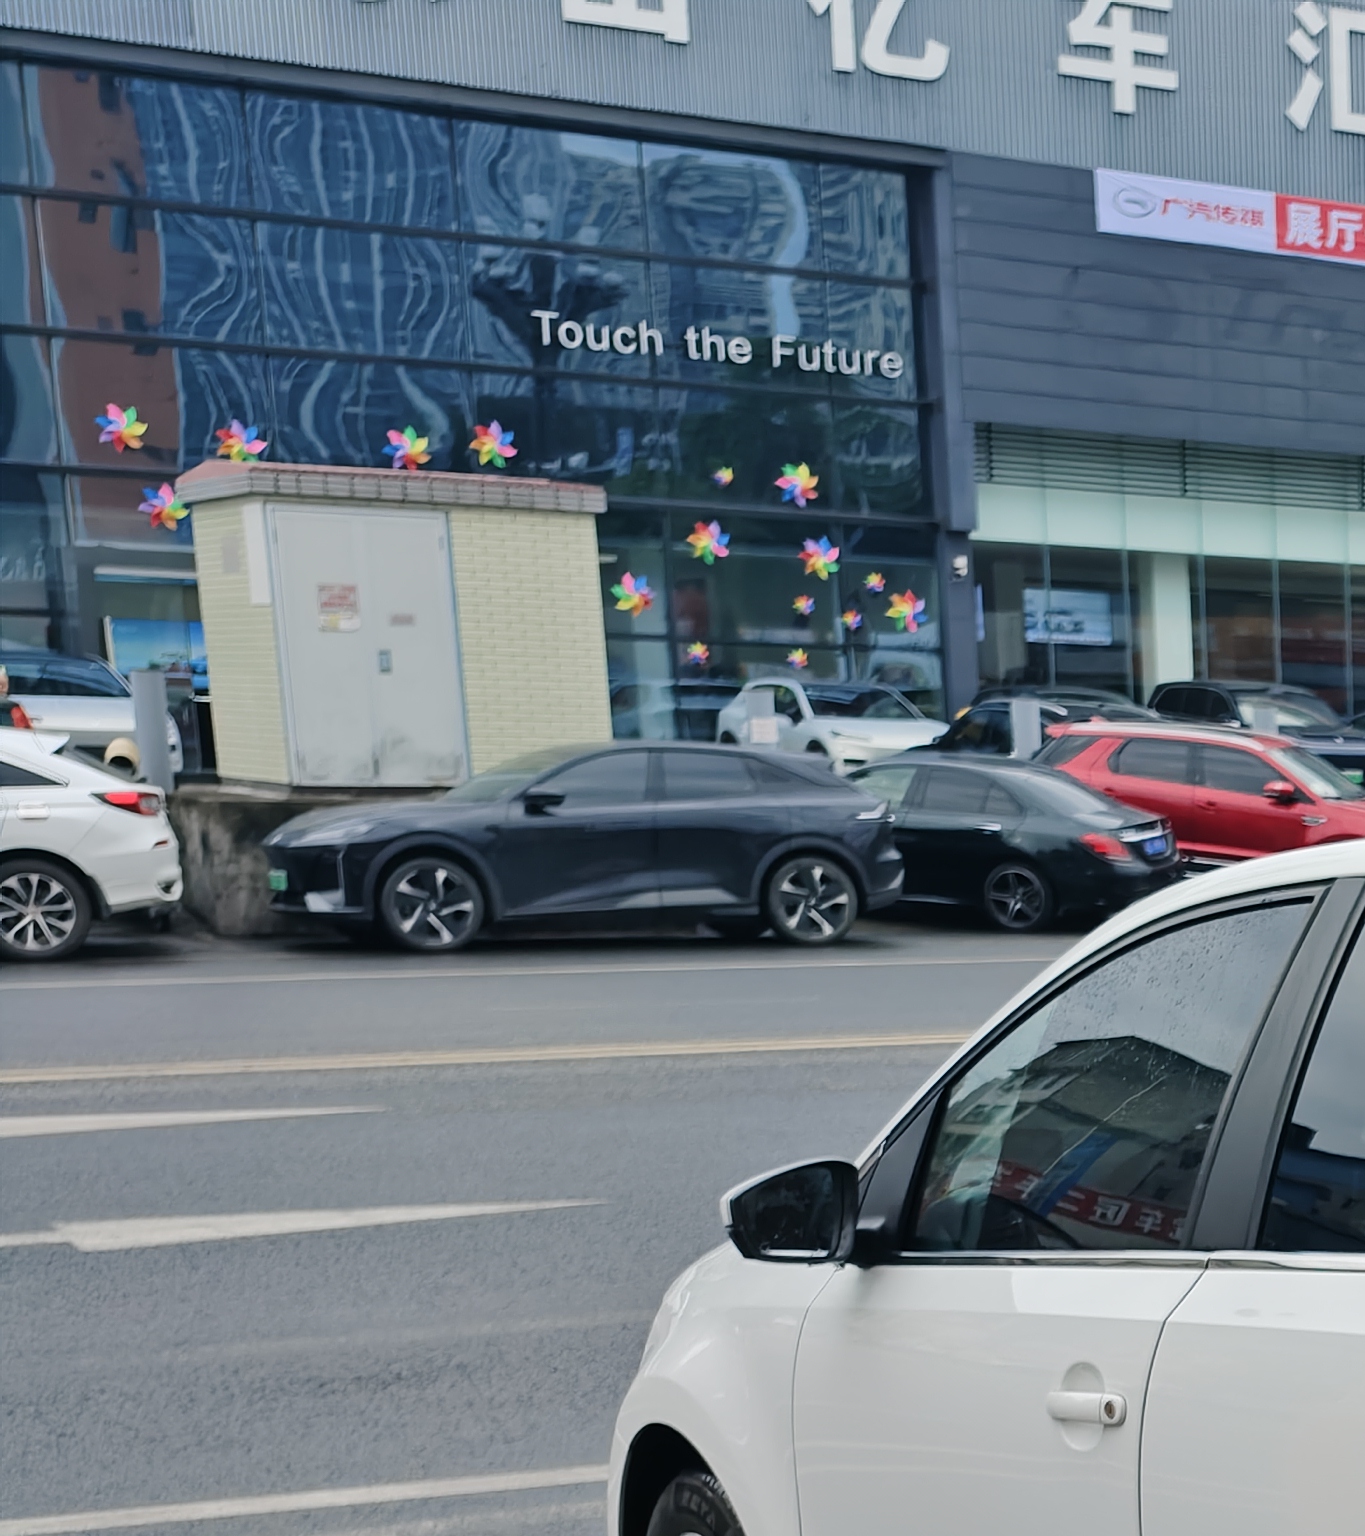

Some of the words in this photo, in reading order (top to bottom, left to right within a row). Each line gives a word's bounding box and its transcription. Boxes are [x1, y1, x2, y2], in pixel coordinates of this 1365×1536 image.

[531, 309, 664, 356] Touch
[684, 325, 753, 364] the
[772, 334, 904, 379] Future
